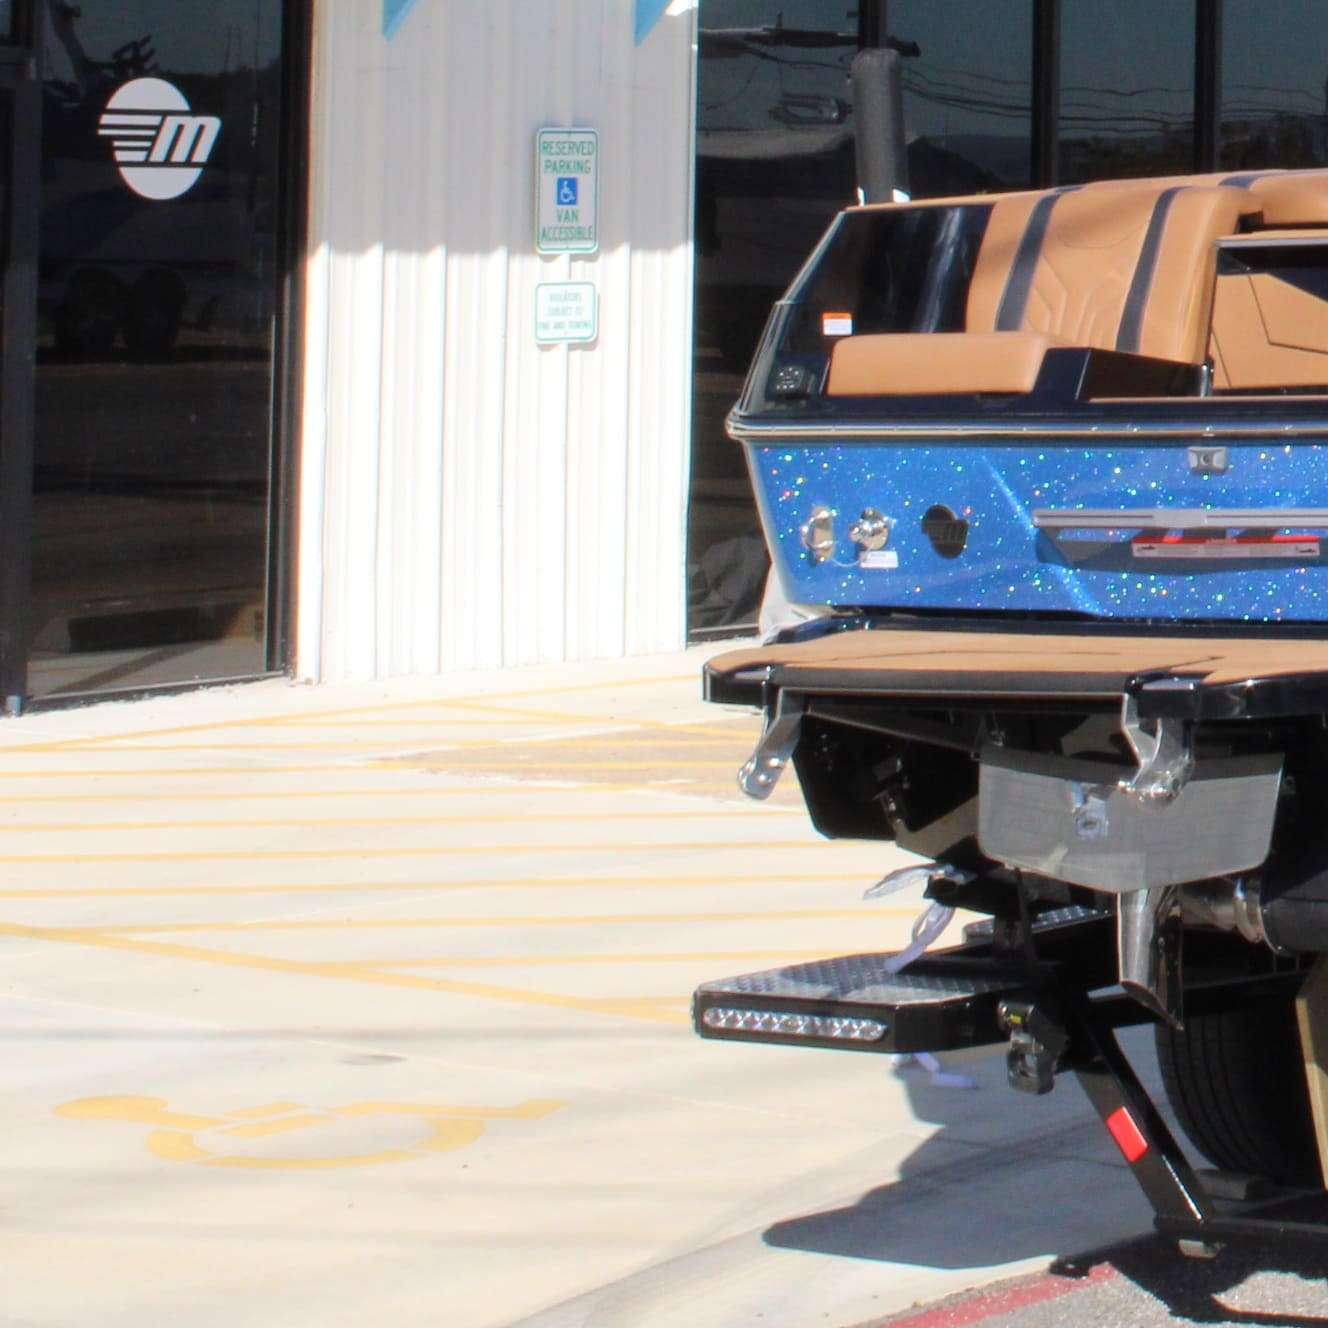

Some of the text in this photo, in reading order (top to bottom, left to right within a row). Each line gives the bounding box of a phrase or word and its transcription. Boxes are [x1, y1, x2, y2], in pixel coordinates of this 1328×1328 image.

[542, 140, 594, 156] RESERVED
[545, 159, 591, 174] PARKING
[556, 208, 578, 223] VAN
[542, 225, 593, 241] ACCESSIBLE
